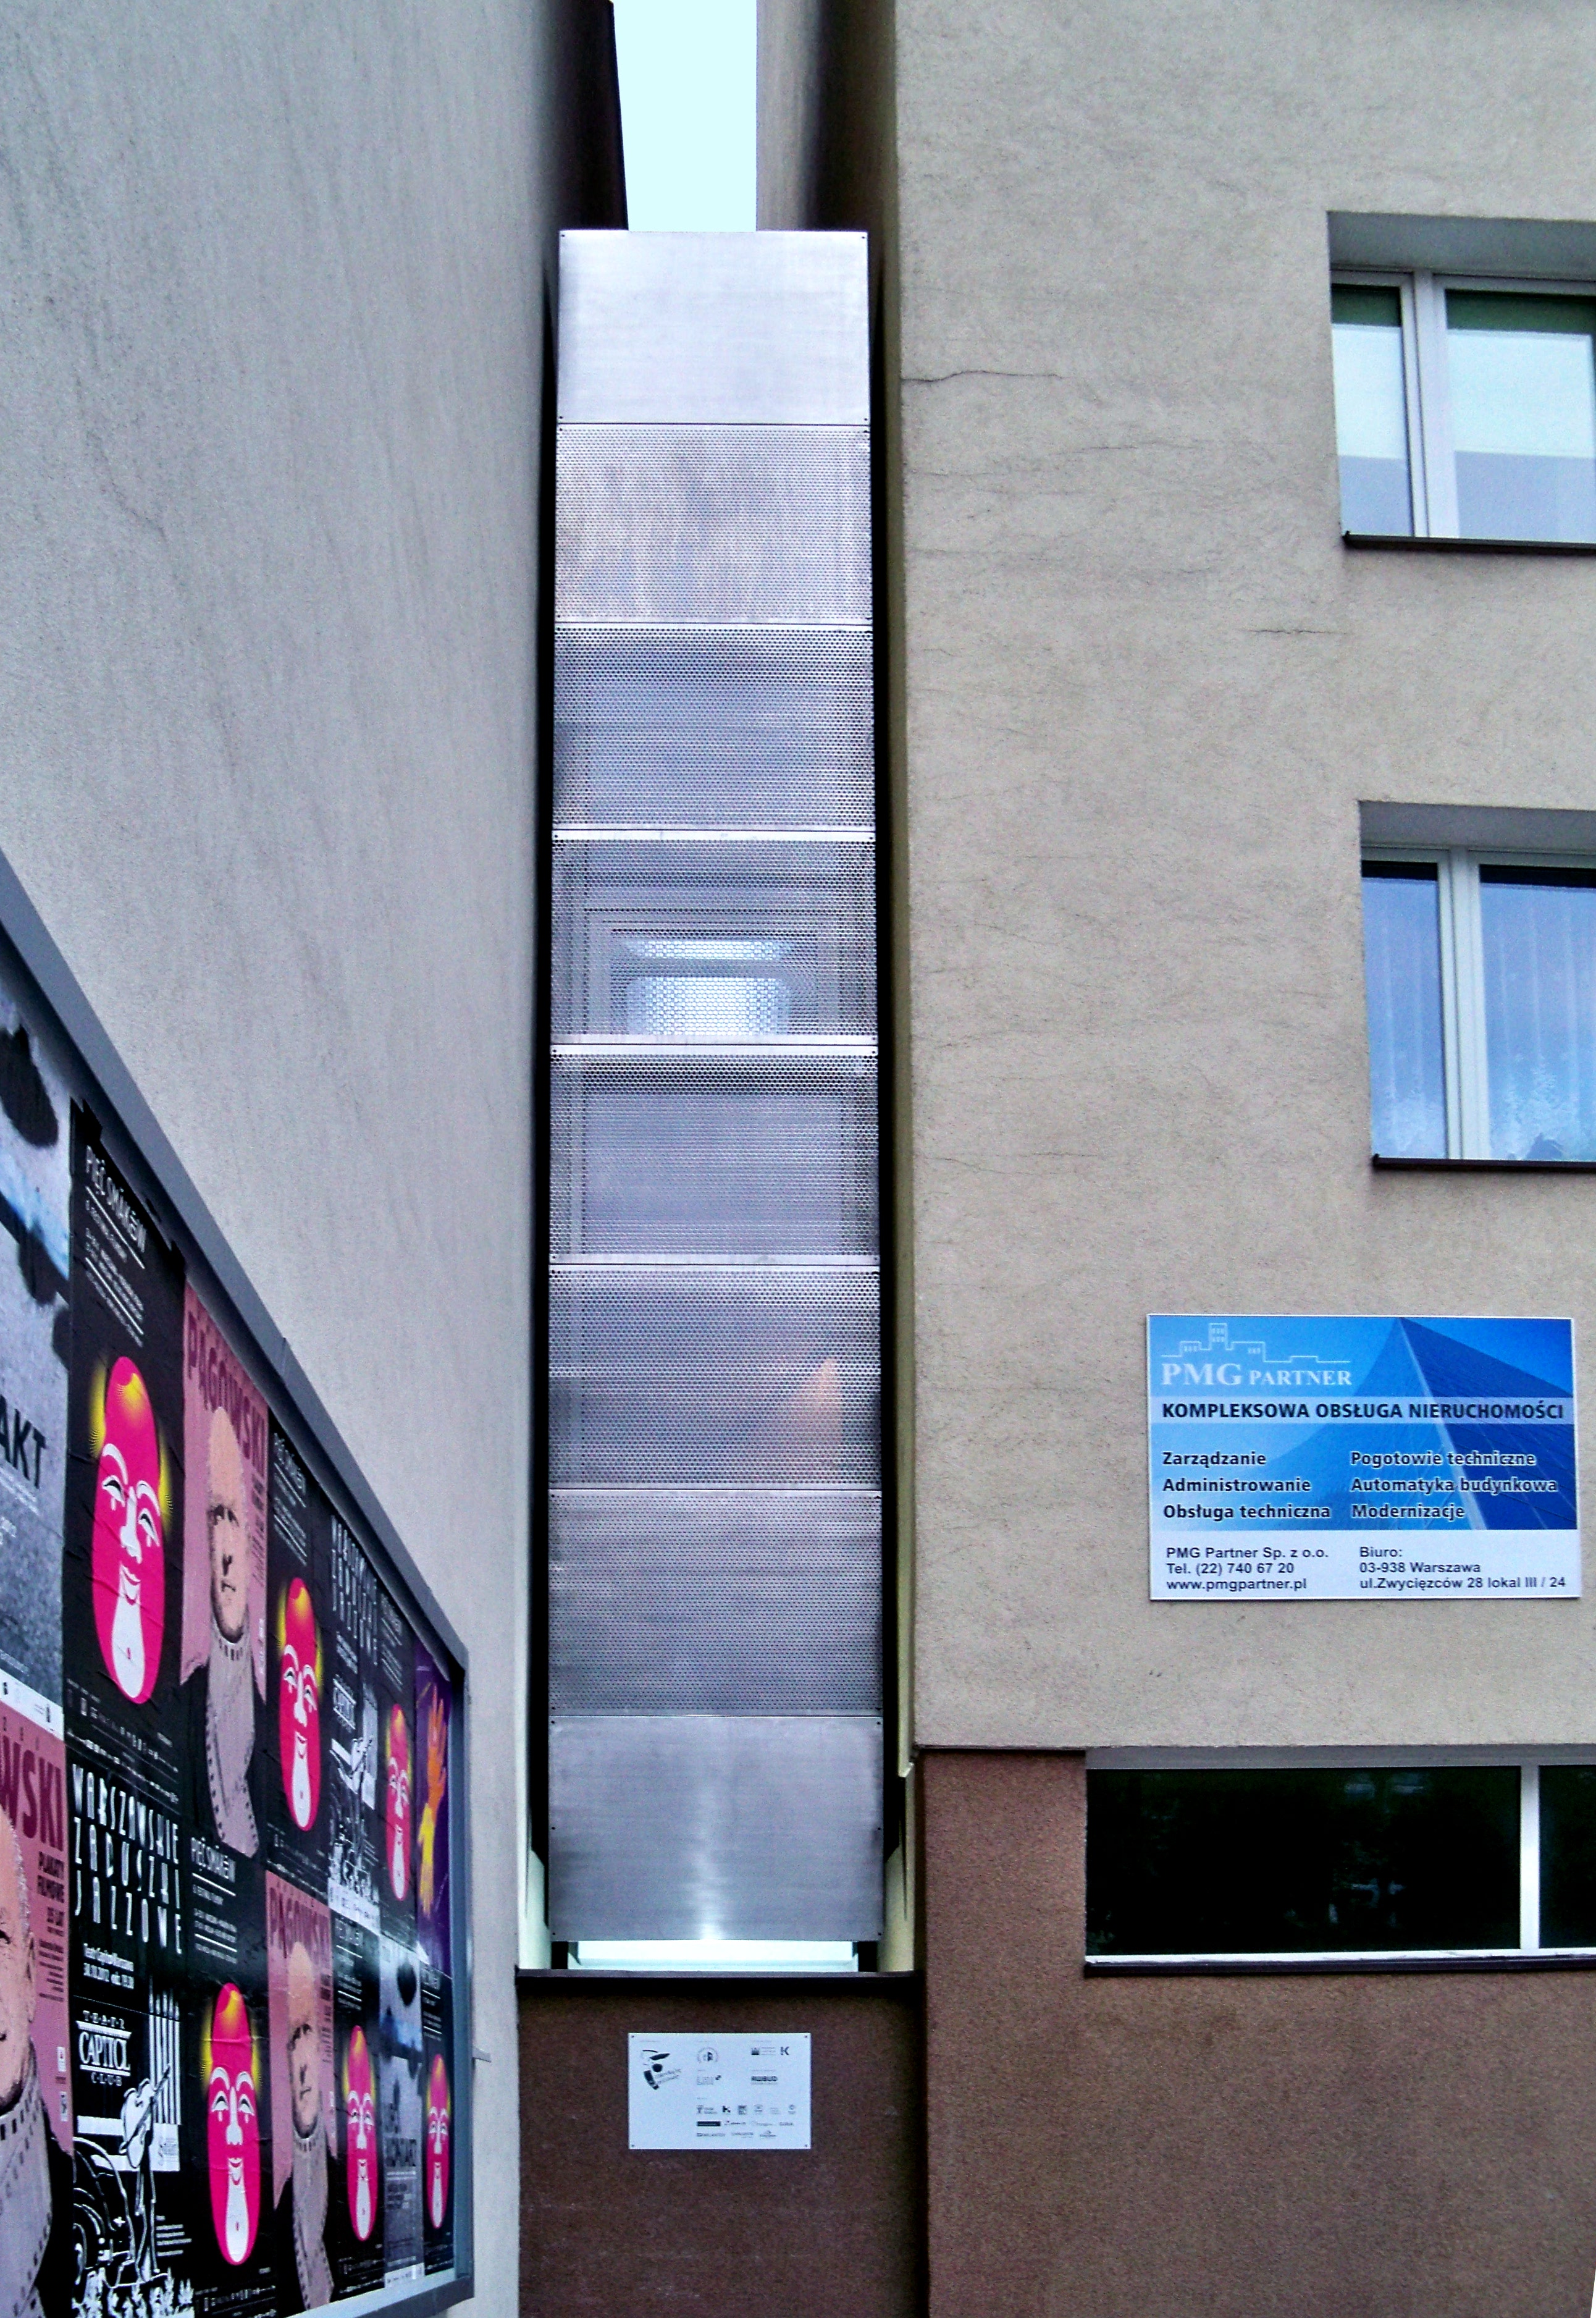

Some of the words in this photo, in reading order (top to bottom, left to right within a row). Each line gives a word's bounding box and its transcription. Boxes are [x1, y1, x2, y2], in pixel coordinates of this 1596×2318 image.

[1162, 1363, 1243, 1386] PMG
[1249, 1370, 1352, 1386] PARTNER
[1162, 1403, 1309, 1418] KOMPLEKSOWA
[1316, 1403, 1403, 1418] OBSŁUGA
[1409, 1401, 1564, 1420] NIERUCHOMOŚCI
[1162, 1451, 1267, 1469] Zarządzanie
[1351, 1451, 1442, 1469] Pogotowie
[1447, 1451, 1537, 1466] techniczne
[1162, 1477, 1311, 1491] Administrowanie
[1351, 1477, 1455, 1495] Automatyka
[1460, 1477, 1558, 1495] budynkowa
[1164, 1504, 1235, 1522] Obsługa
[1239, 1504, 1330, 1518] techniczna
[1351, 1503, 1466, 1521] Modernizacje
[1166, 1547, 1201, 1558] PMG
[1206, 1547, 1258, 1558] Partner
[1262, 1546, 1285, 1561] Sp.
[1290, 1550, 1298, 1558] z
[1302, 1549, 1329, 1558] o.o.
[1359, 1546, 1403, 1558] Biuro:
[1166, 1563, 1191, 1574] Tel.
[1196, 1562, 1222, 1576] (22)
[1227, 1562, 1252, 1574] 740
[1258, 1562, 1274, 1574] 67
[1278, 1562, 1294, 1574] 20
[1359, 1562, 1406, 1574] 03-938
[1409, 1562, 1481, 1574] Warszawa
[1167, 1578, 1307, 1591] www.pmgpartner.pl
[1360, 1577, 1463, 1591] ul.Zwycięzców
[1467, 1577, 1484, 1588] 28
[1488, 1577, 1521, 1588] lokal
[1525, 1577, 1537, 1588] III
[1549, 1577, 1566, 1588] 24
[74, 1869, 182, 1954] JAZZOWE
[78, 2031, 131, 2071] CAPITOL
